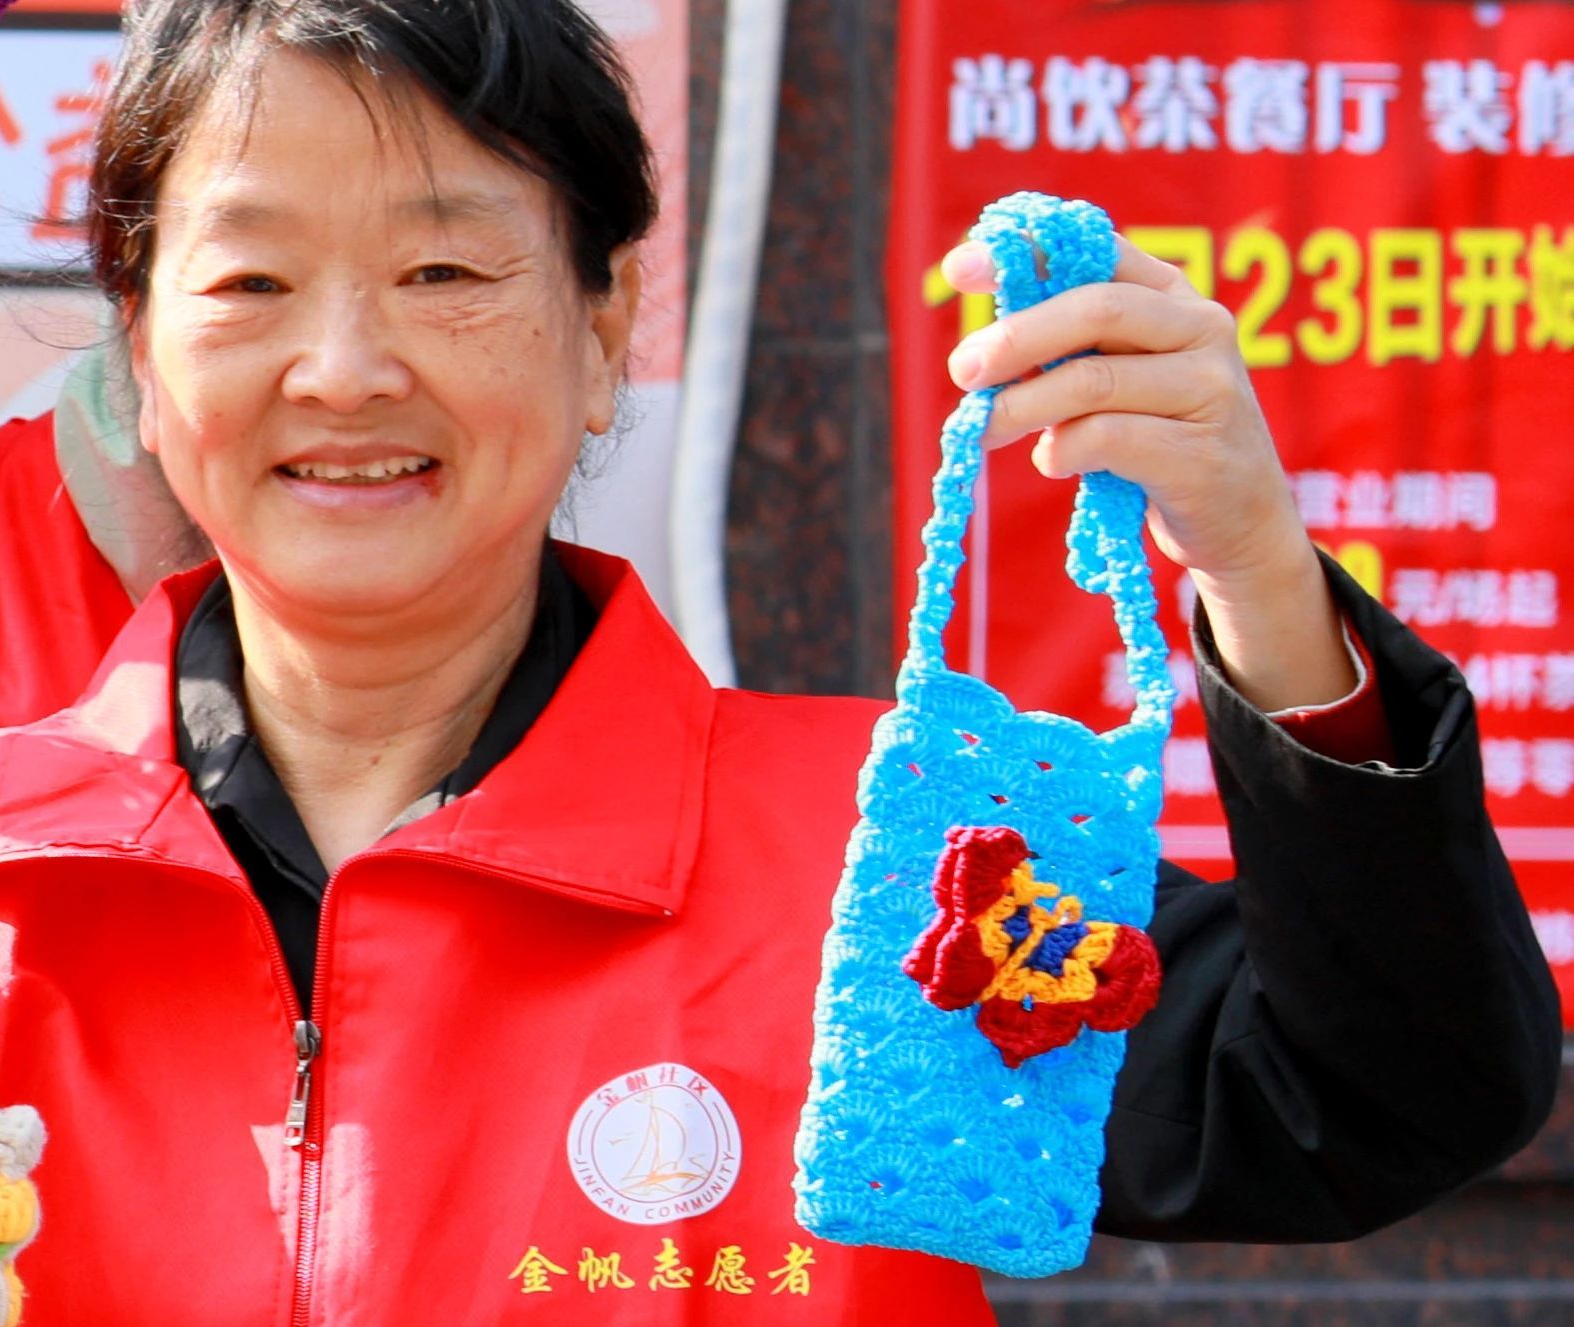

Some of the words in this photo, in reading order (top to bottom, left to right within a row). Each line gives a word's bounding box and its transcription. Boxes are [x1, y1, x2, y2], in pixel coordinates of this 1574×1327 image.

[947, 52, 1401, 154] 尚饮茶餐厅
[596, 1065, 710, 1108] 金帆社区
[573, 1157, 632, 1216] JINFAN
[644, 1150, 737, 1220] COMMUNITY
[507, 1236, 817, 1297] 金帆志愿者
